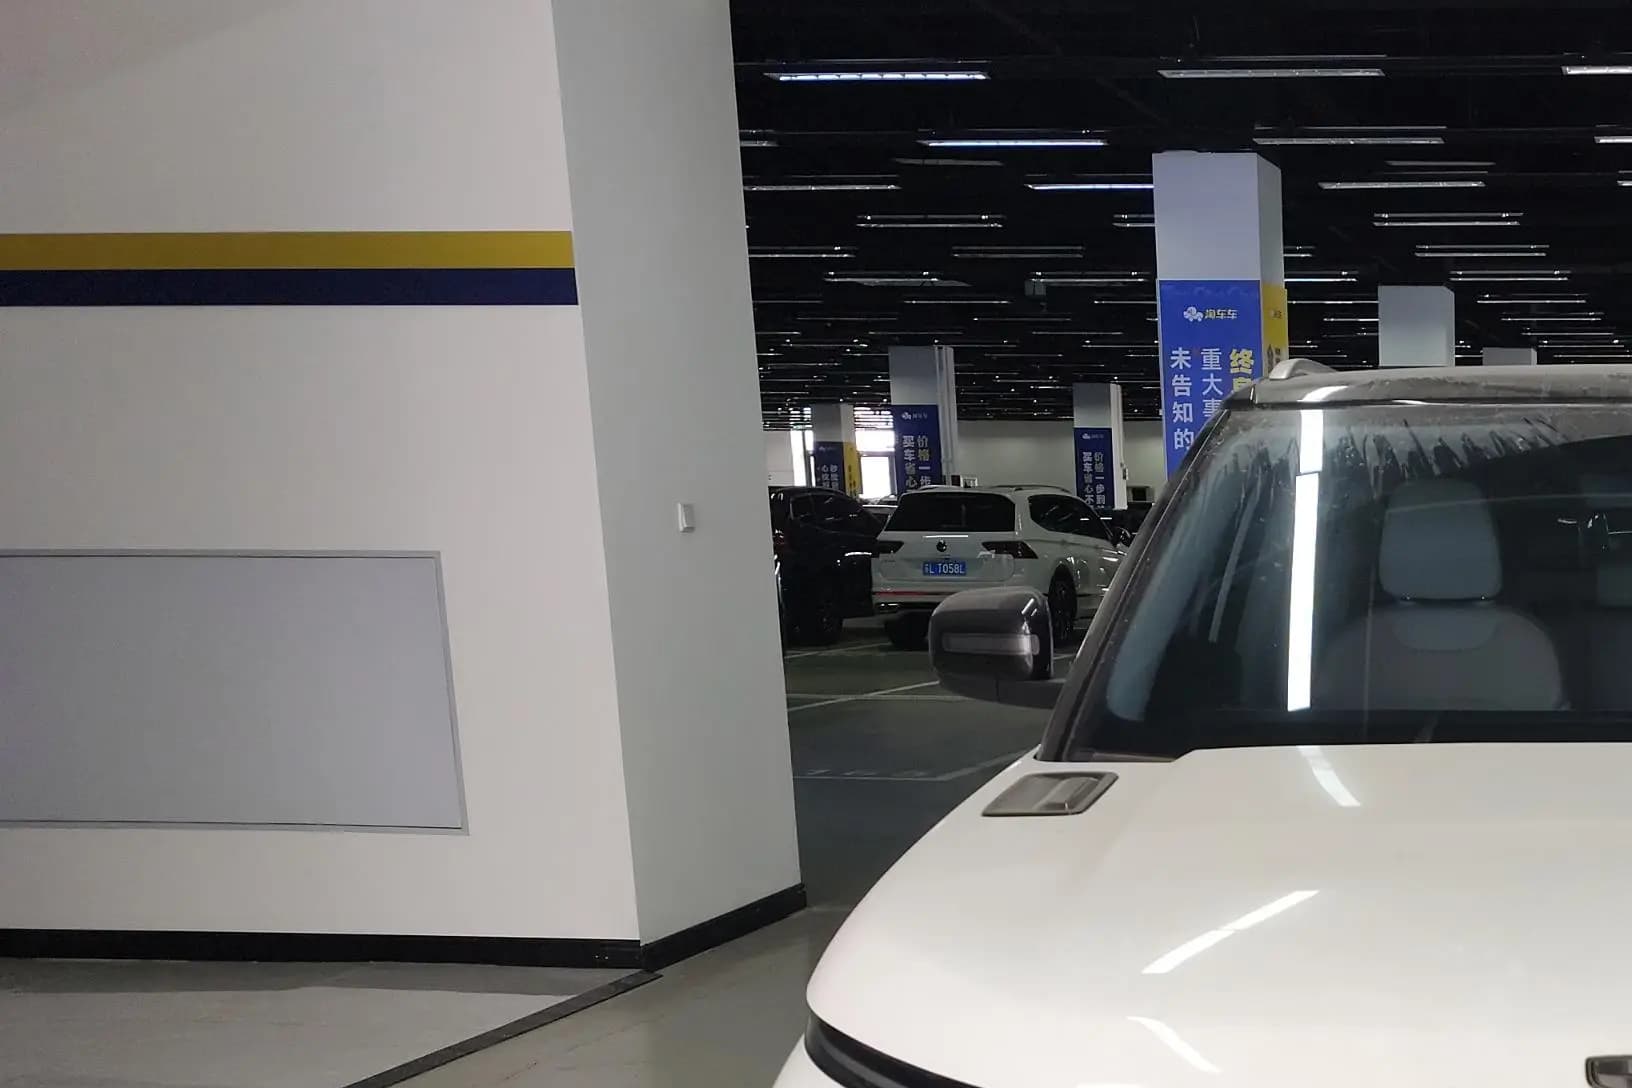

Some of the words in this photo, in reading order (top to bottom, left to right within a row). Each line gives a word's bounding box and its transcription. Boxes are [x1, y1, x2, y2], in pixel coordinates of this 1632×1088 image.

[1204, 309, 1239, 320] 淘车车
[1170, 347, 1195, 450] 未告知的
